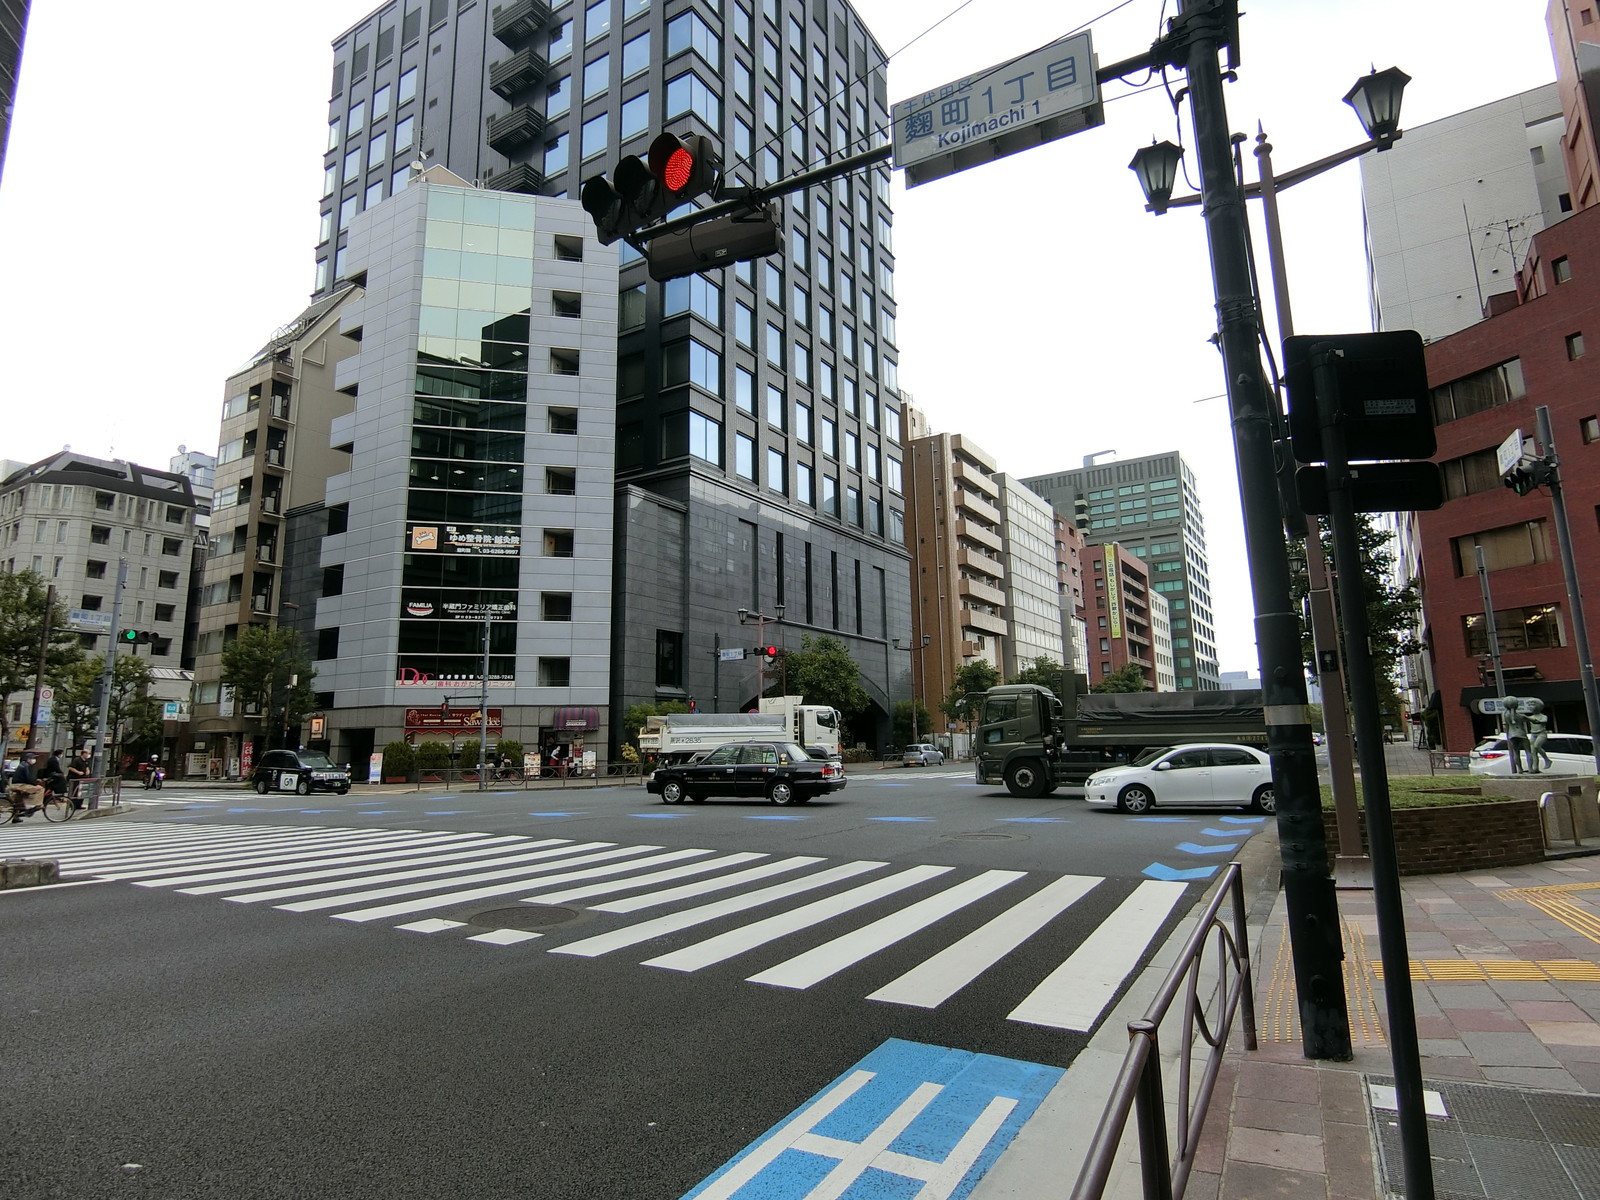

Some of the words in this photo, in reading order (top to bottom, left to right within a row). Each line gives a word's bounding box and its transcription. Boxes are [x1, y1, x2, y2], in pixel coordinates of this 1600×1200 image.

[938, 105, 1025, 148] Kojimachi
[1031, 99, 1041, 115] 1
[463, 716, 501, 727] Sawdee
